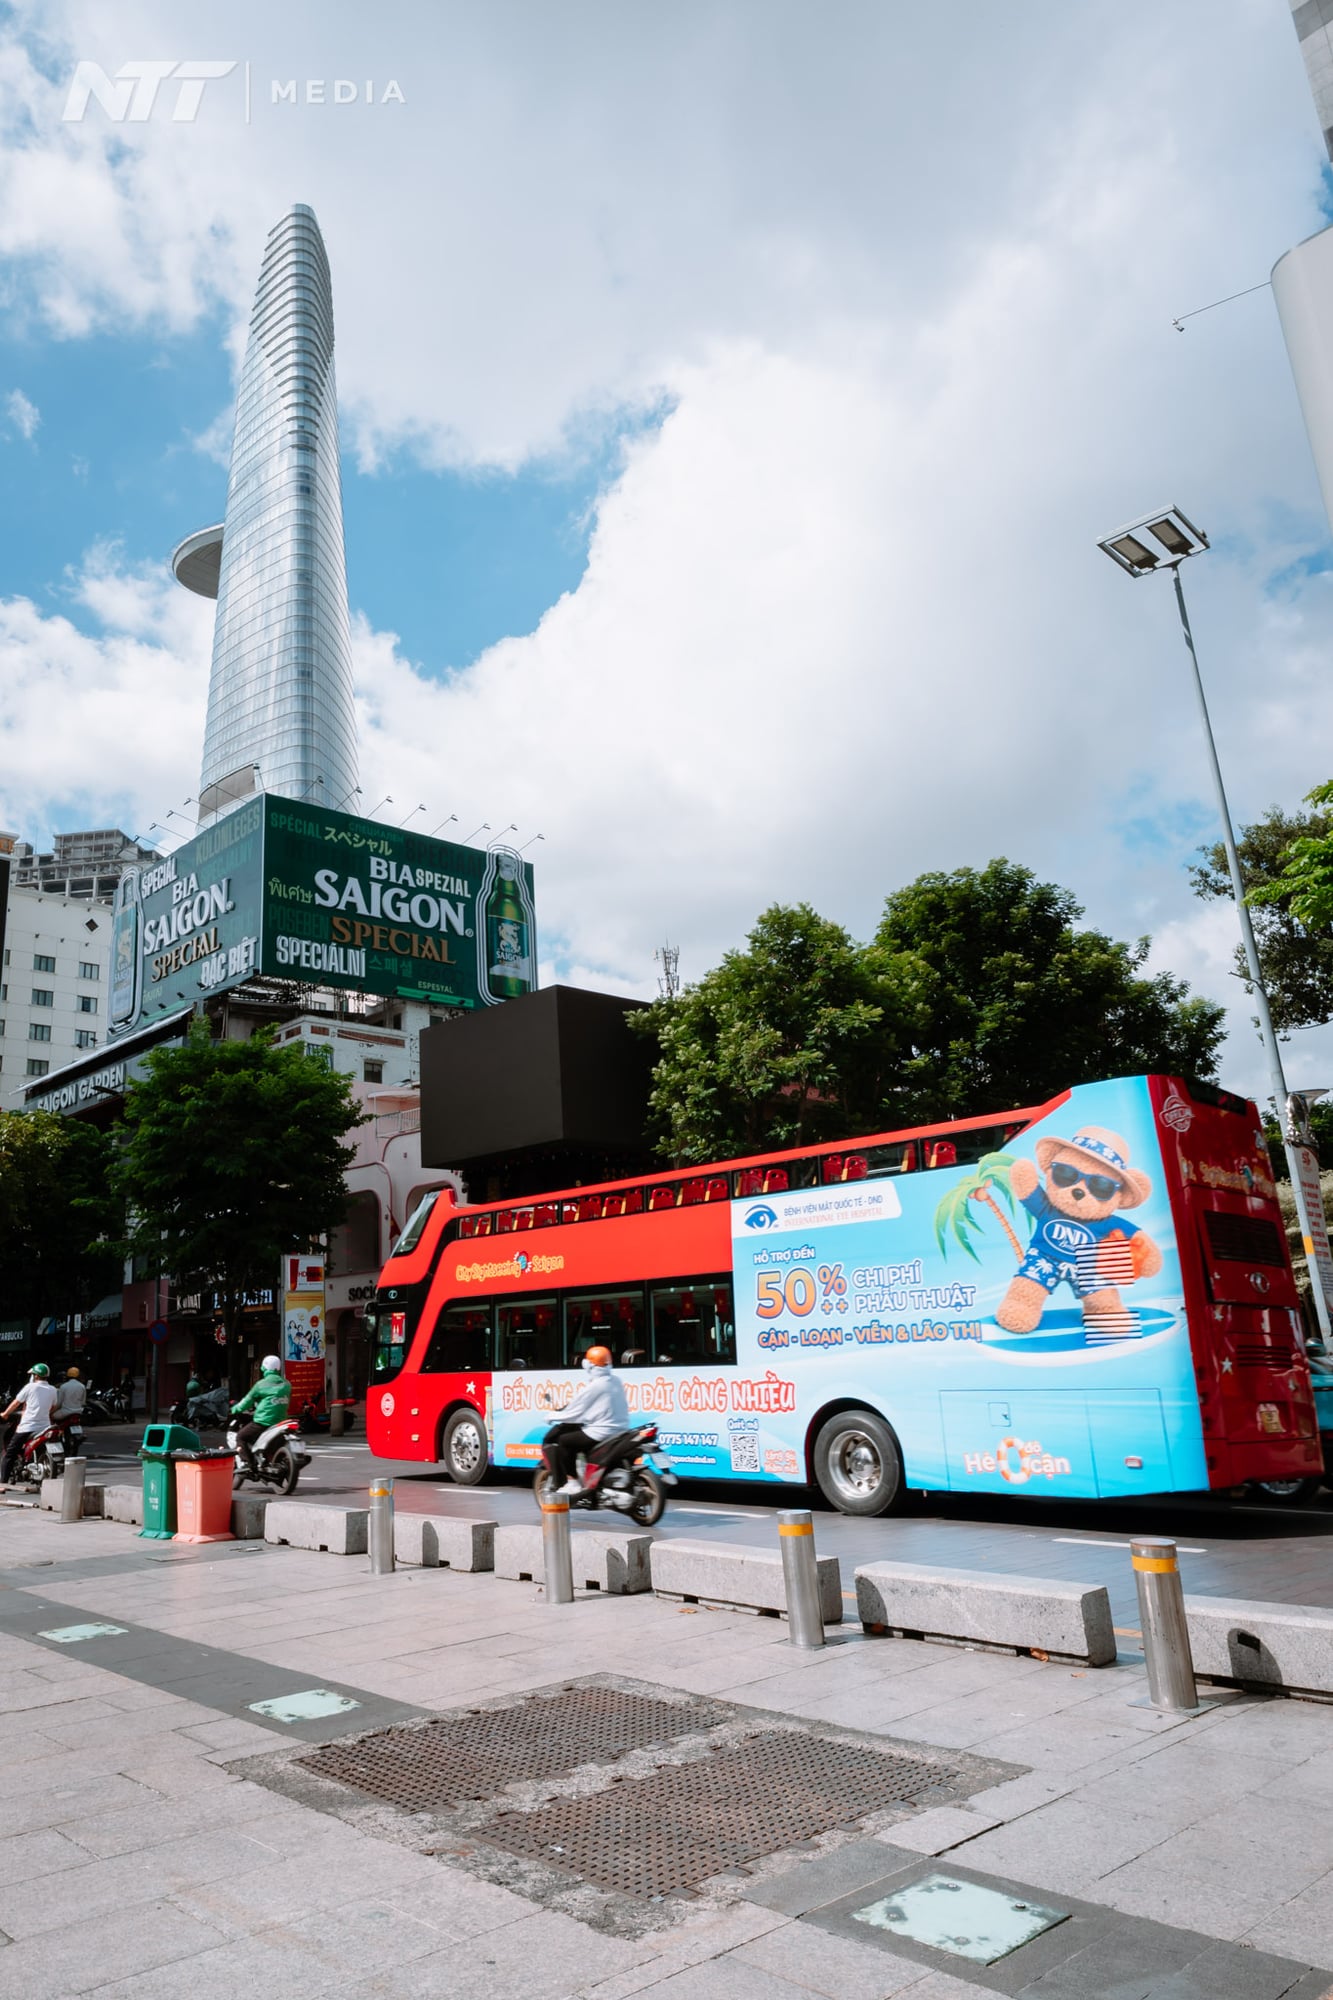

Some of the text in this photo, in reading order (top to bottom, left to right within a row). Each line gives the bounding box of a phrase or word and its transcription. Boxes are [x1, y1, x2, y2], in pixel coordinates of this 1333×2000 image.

[270, 812, 321, 839] SPÉCIAL
[324, 827, 392, 856] スペシャル
[369, 856, 416, 888] BIA
[415, 868, 472, 898] SPEZIAL
[173, 873, 200, 905] BIA
[314, 869, 466, 936] SAIGON
[144, 878, 231, 956] SAIGON
[151, 928, 221, 983] SPECIAL
[331, 916, 457, 965] SPECIAL
[784, 1214, 834, 1227] INTERNATIONAL
[851, 1207, 883, 1219] HOSPITAL
[1052, 1223, 1088, 1245] DND
[793, 1246, 815, 1260] ĐẾN
[758, 1328, 789, 1351] CẬN
[800, 1327, 843, 1348] LOẠN
[896, 1326, 909, 1342] &
[912, 1319, 948, 1341] LÃO
[503, 1377, 532, 1411] ĐẾN
[641, 1376, 674, 1412] ĐÃI
[679, 1376, 728, 1413] CÀNG
[731, 1370, 795, 1413] NHIỀU
[683, 1433, 699, 1446] 147
[700, 1433, 718, 1447] 147
[1030, 1453, 1071, 1480] cận
